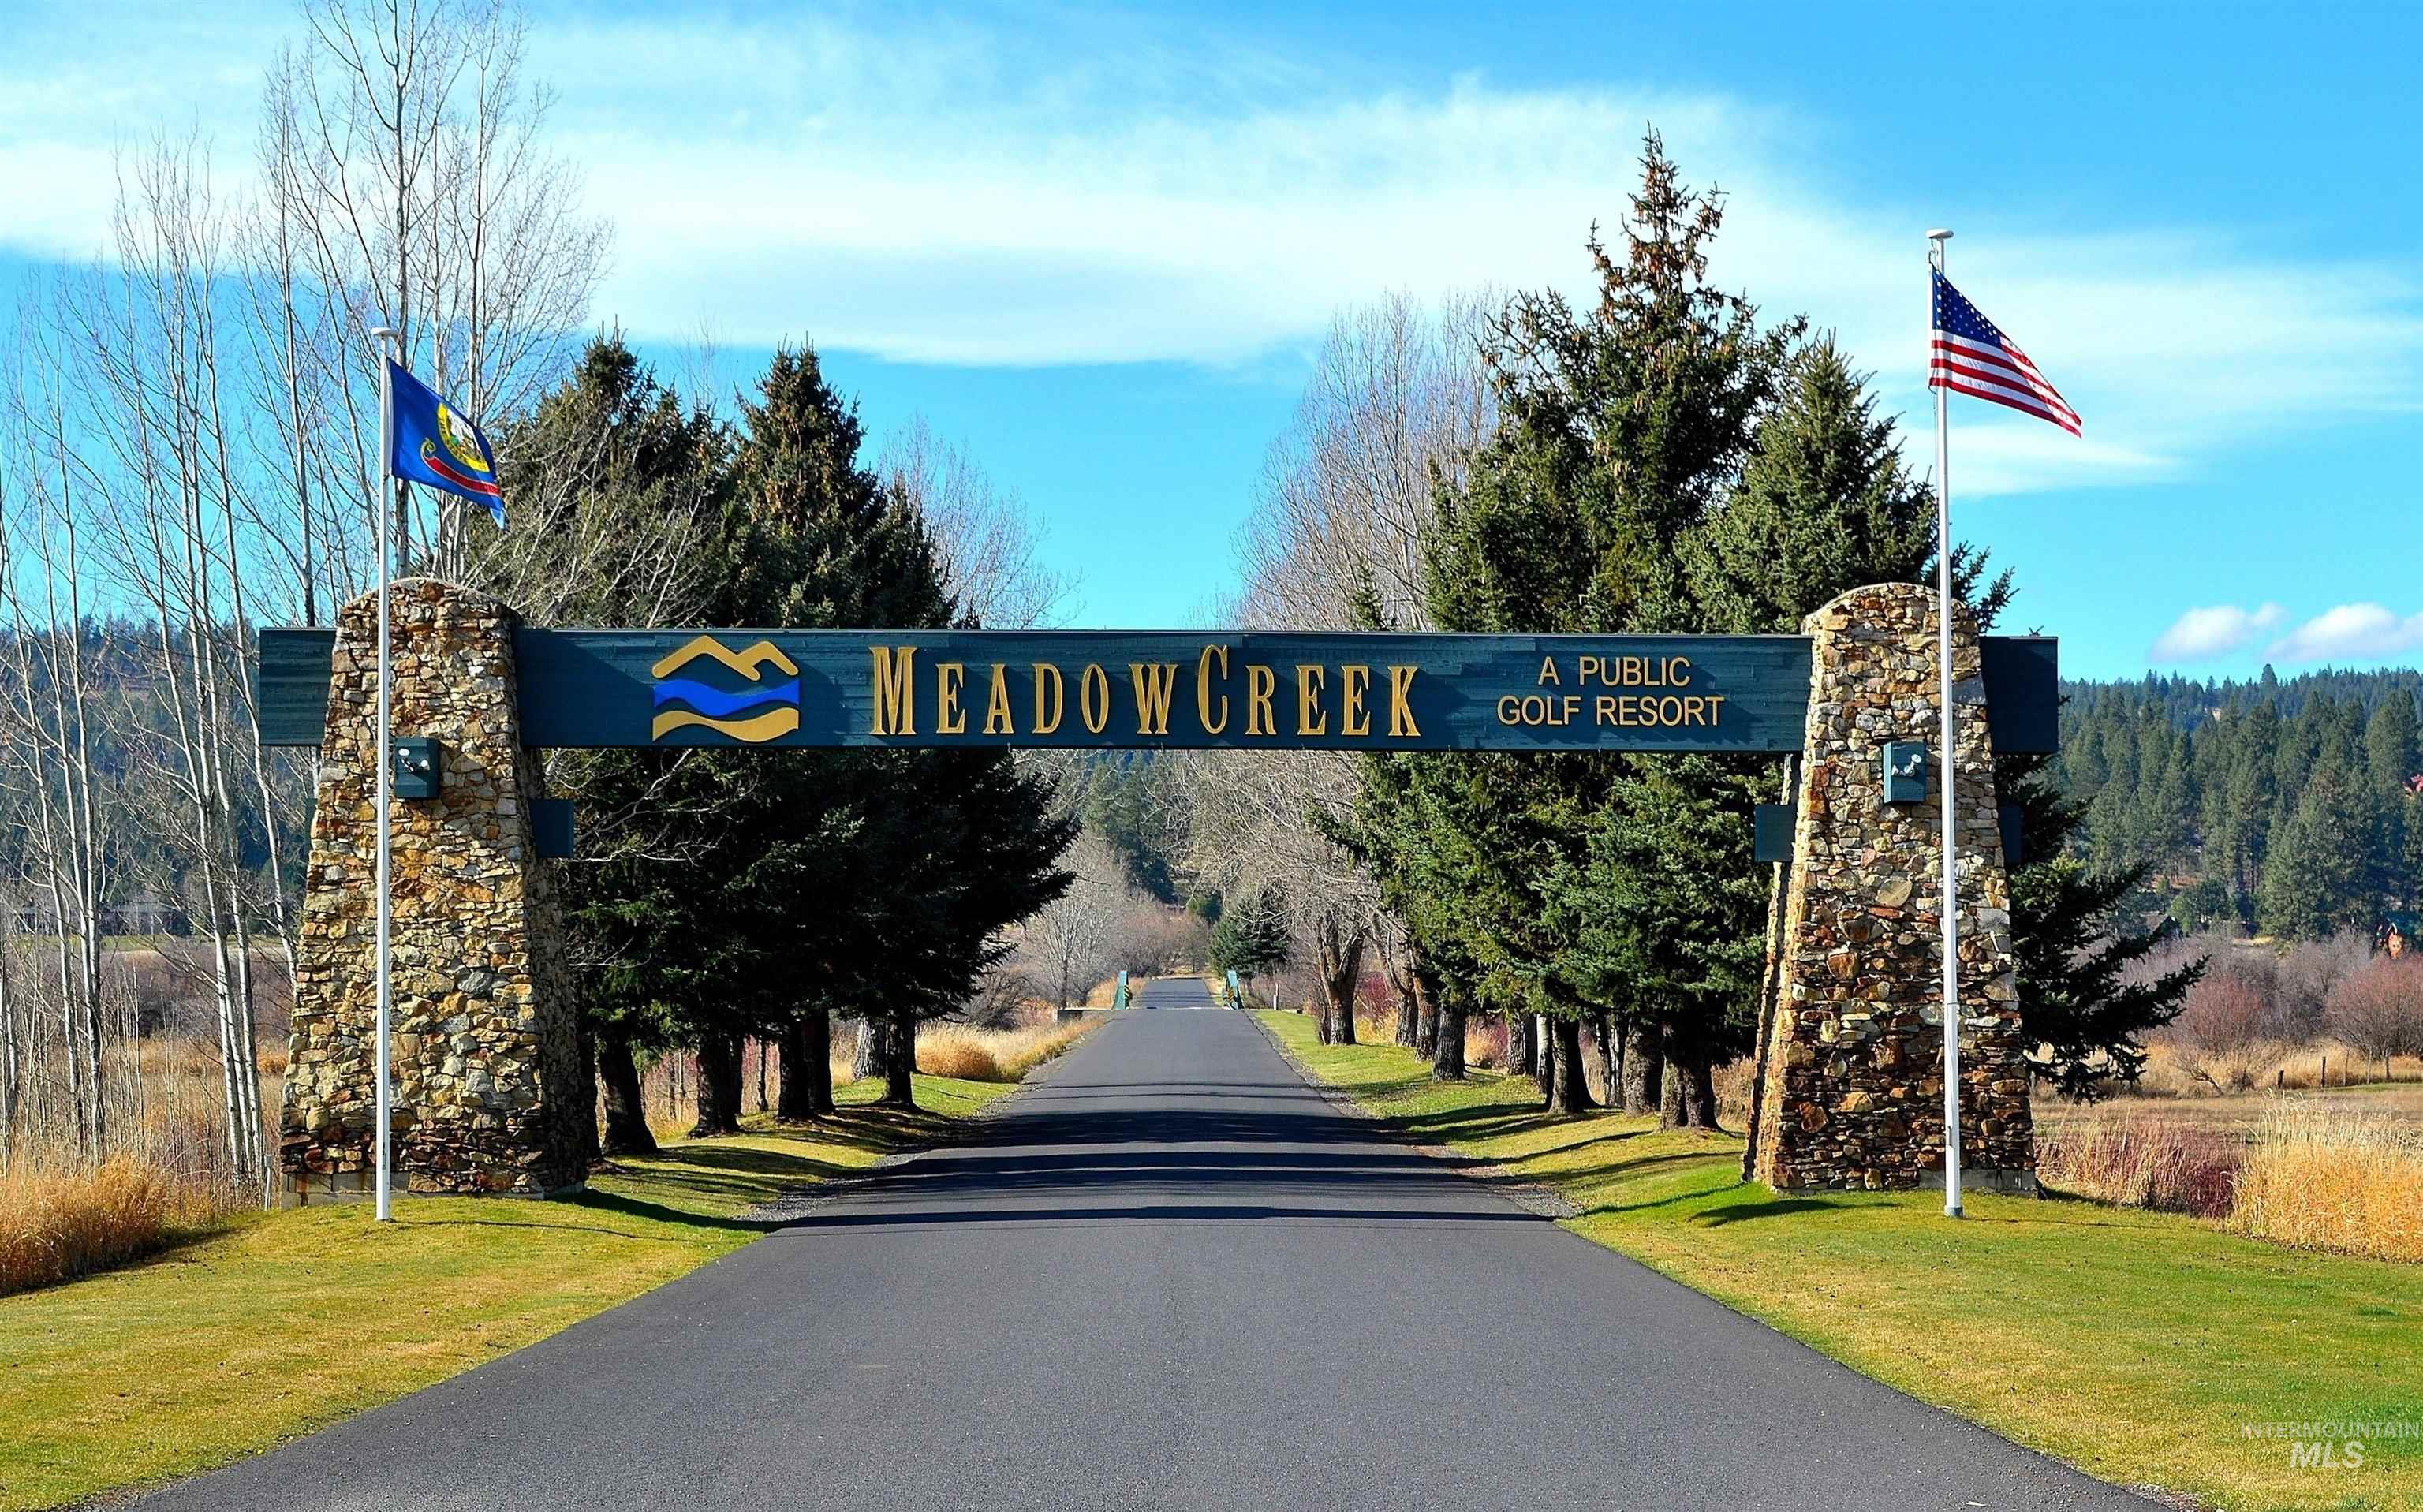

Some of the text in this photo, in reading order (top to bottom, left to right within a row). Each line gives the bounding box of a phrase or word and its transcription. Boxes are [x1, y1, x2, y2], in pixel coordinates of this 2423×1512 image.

[1538, 656, 1691, 687] A PUBLIC
[1497, 695, 1725, 726] GOLF RESORT
